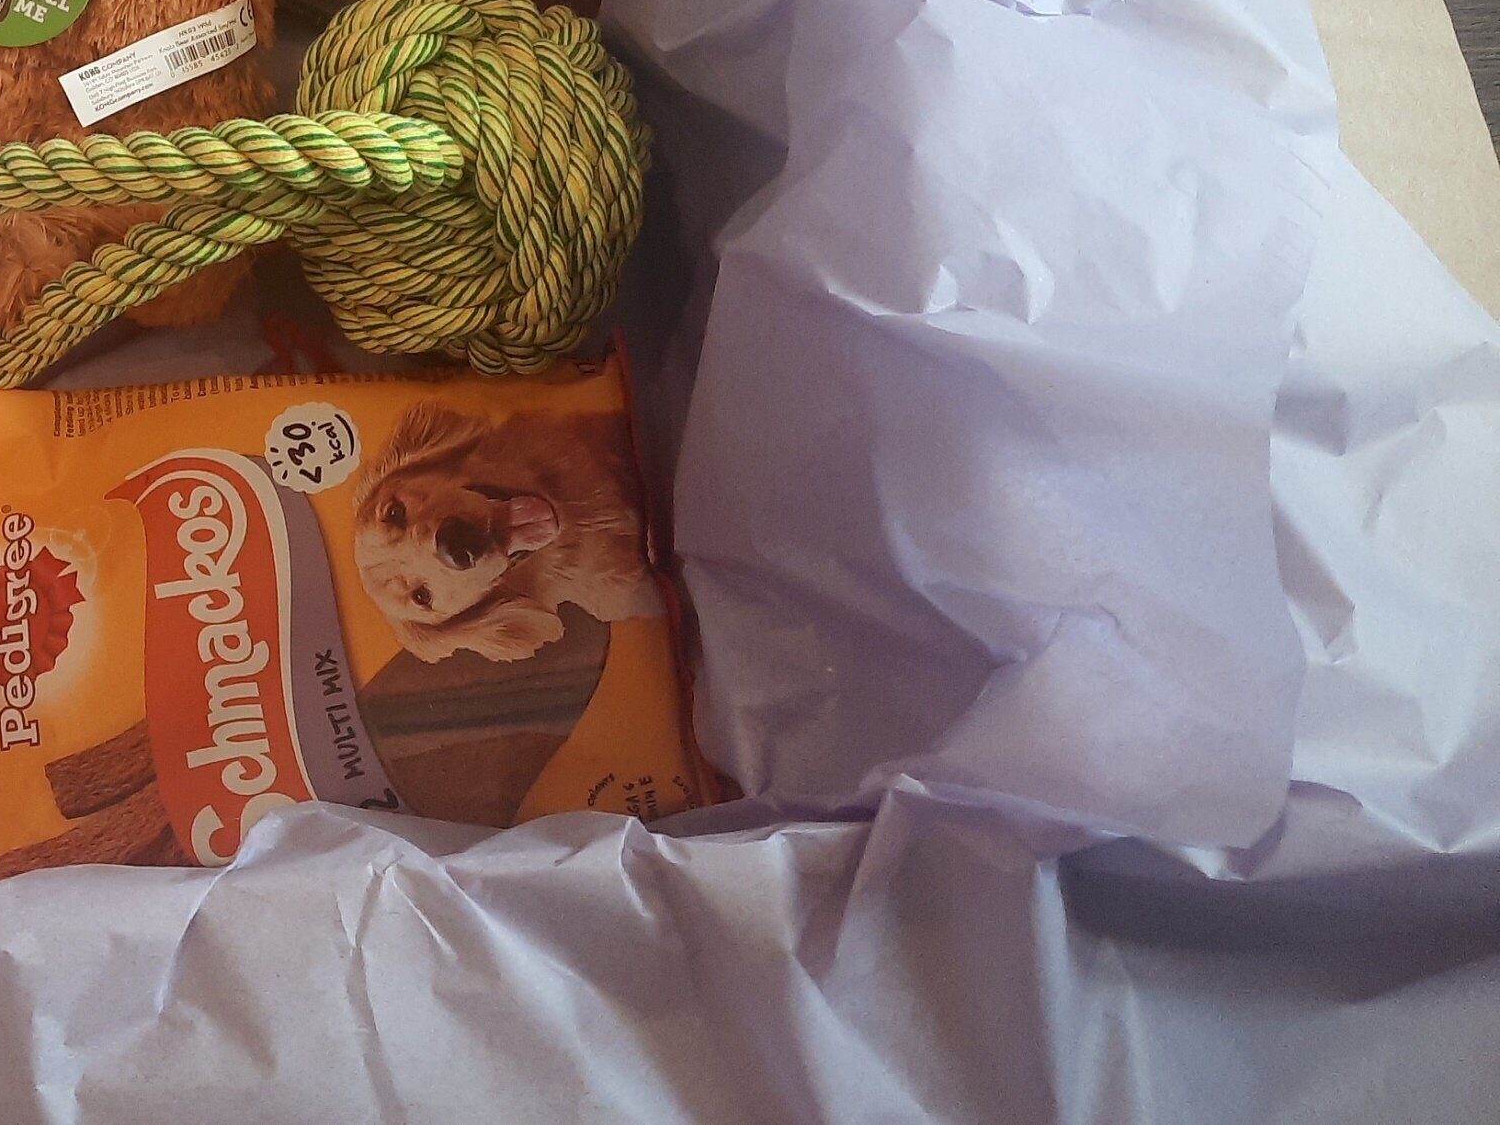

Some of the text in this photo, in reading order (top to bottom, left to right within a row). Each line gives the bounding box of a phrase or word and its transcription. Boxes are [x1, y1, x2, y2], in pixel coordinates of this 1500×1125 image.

[78, 65, 101, 82] KONG
[282, 422, 322, 484] <30
[154, 484, 302, 867] Schmackos
[314, 648, 366, 780] MULTI MIX
